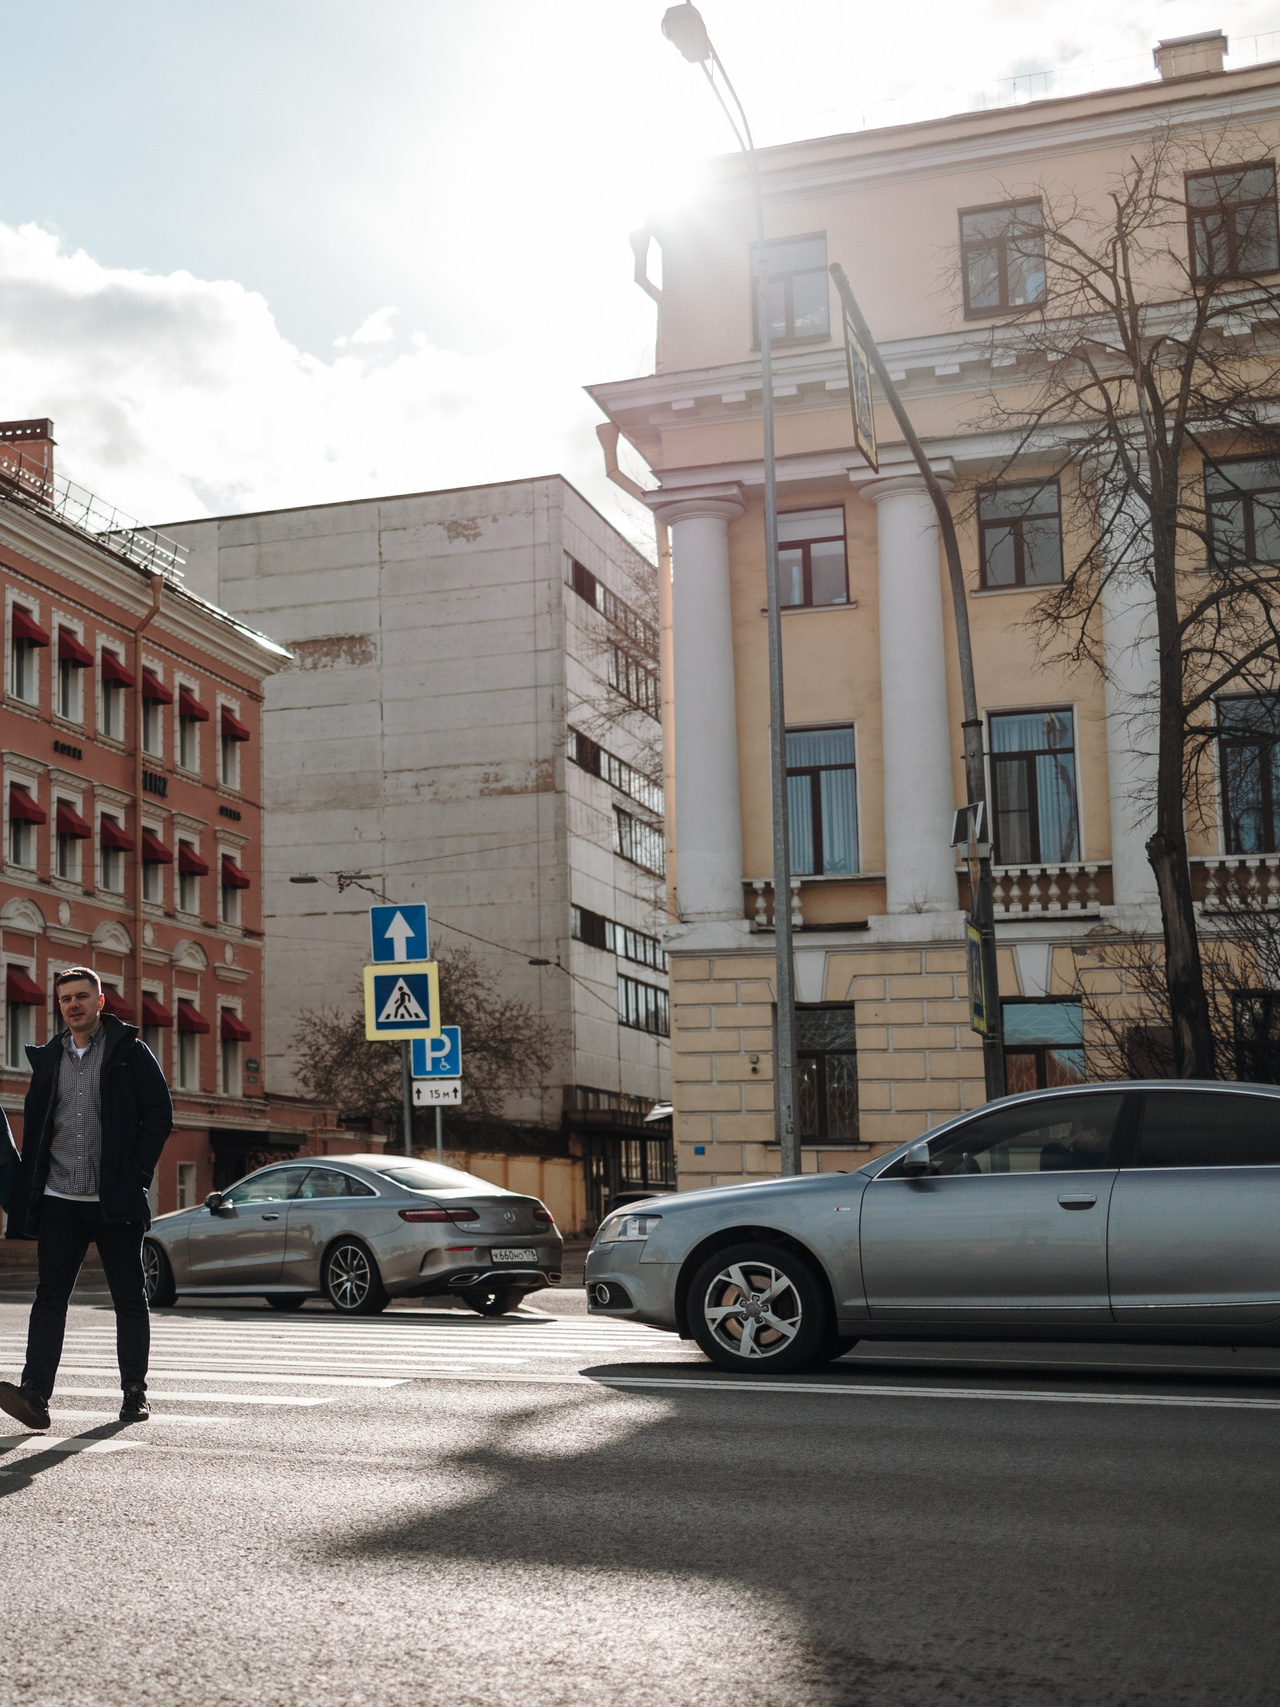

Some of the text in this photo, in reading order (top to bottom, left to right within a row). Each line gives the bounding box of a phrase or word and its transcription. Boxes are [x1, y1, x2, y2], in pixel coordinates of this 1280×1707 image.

[142, 769, 168, 798] LINZ
[425, 1034, 451, 1071] P
[430, 1089, 440, 1099] 15
